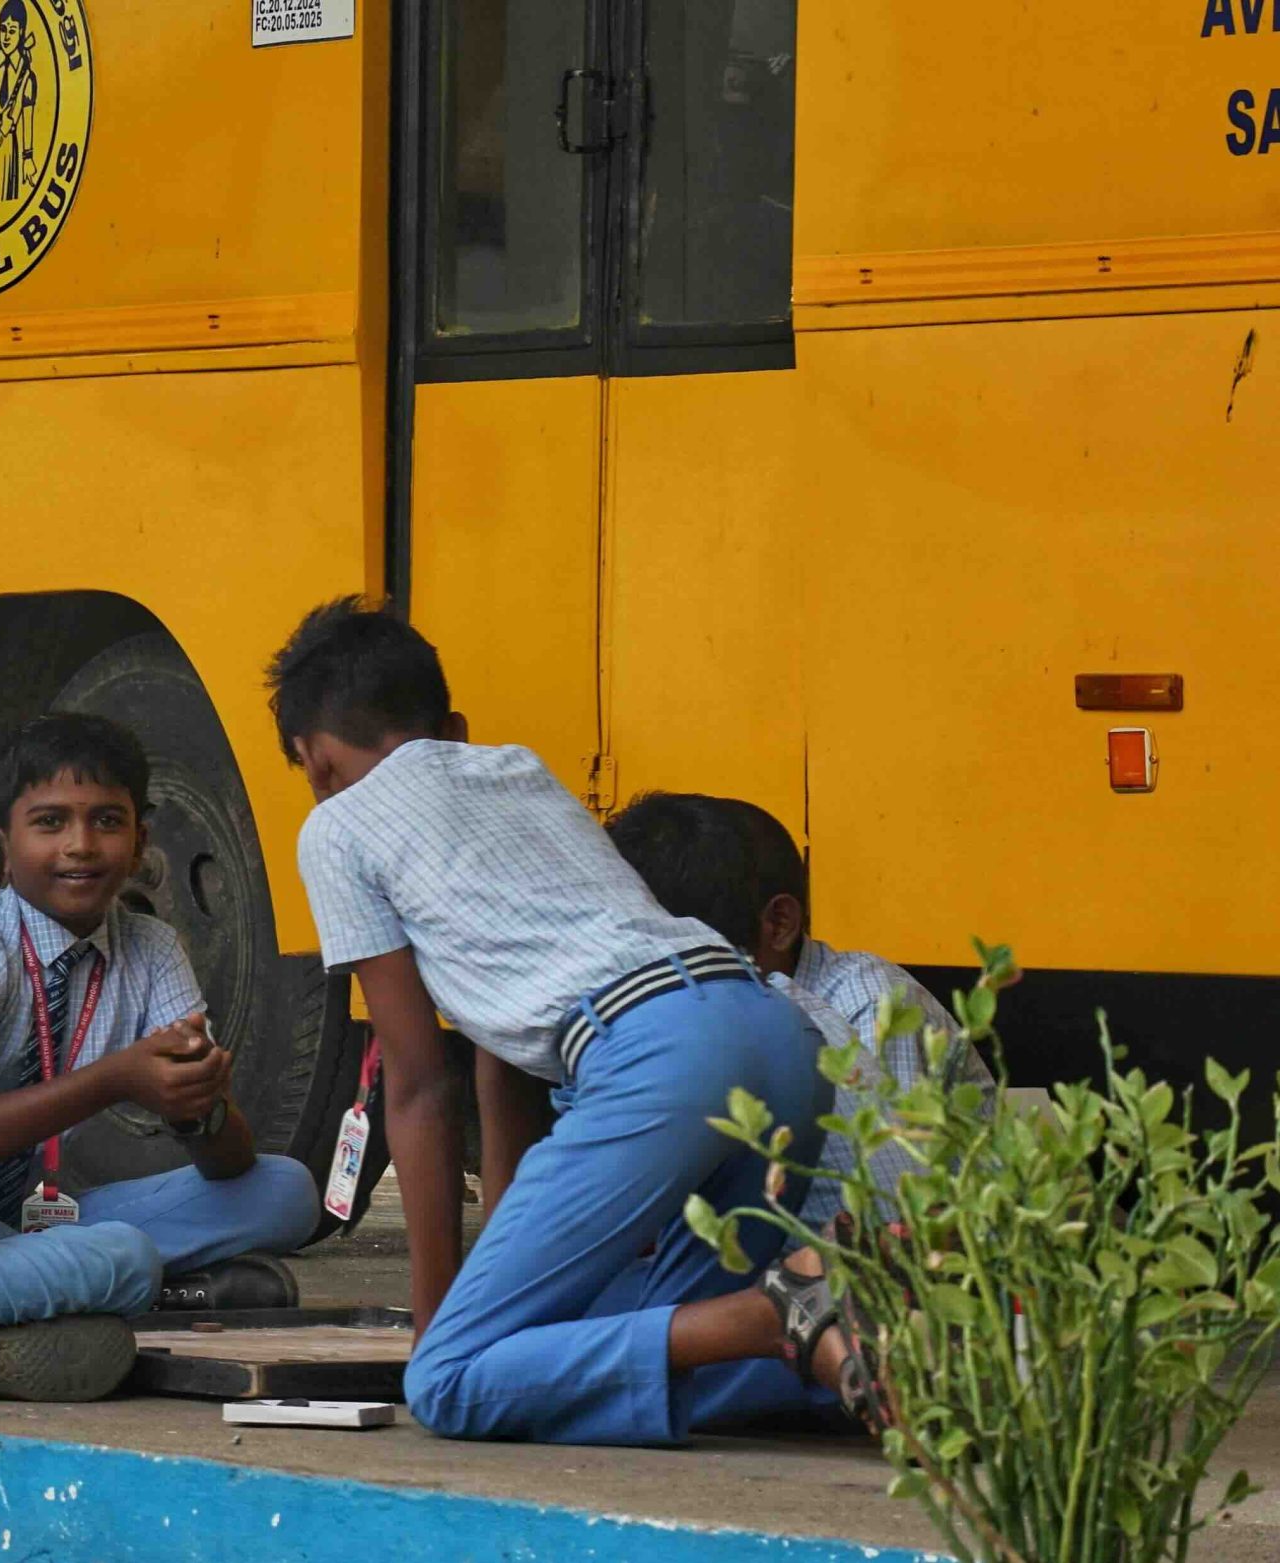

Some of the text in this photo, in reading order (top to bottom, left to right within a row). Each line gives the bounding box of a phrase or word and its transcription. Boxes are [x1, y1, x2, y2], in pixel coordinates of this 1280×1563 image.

[256, 12, 322, 32] FC:20.05.2025
[1226, 88, 1280, 156] SA
[19, 142, 79, 255] BUS
